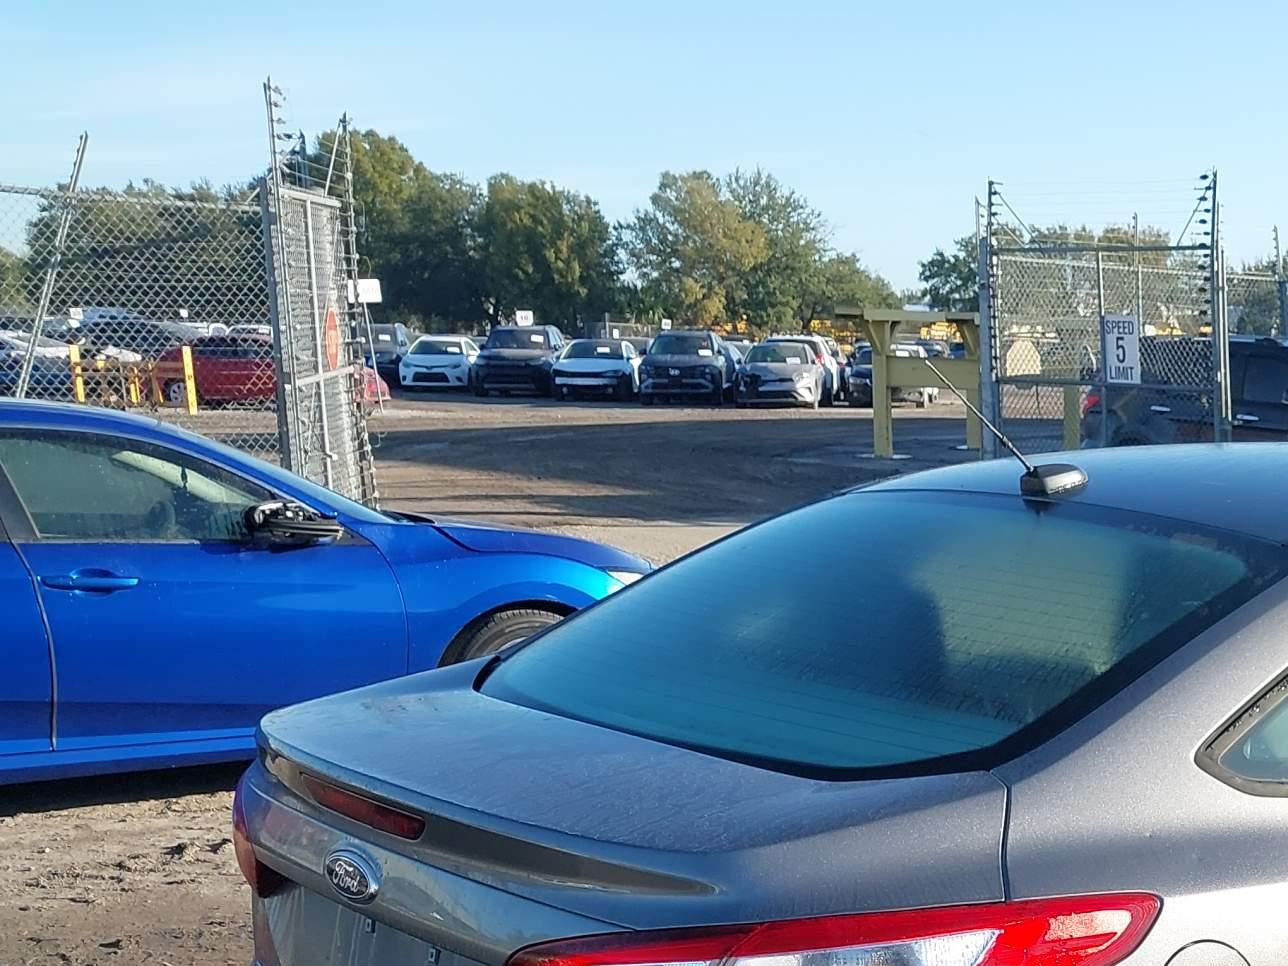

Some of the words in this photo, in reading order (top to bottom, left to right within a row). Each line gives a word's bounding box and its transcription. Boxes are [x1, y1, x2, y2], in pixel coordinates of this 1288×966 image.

[1105, 320, 1135, 335] SPEED
[1116, 336, 1126, 363] 5
[1109, 366, 1135, 381] LIMIT
[332, 860, 360, 893] Ford
